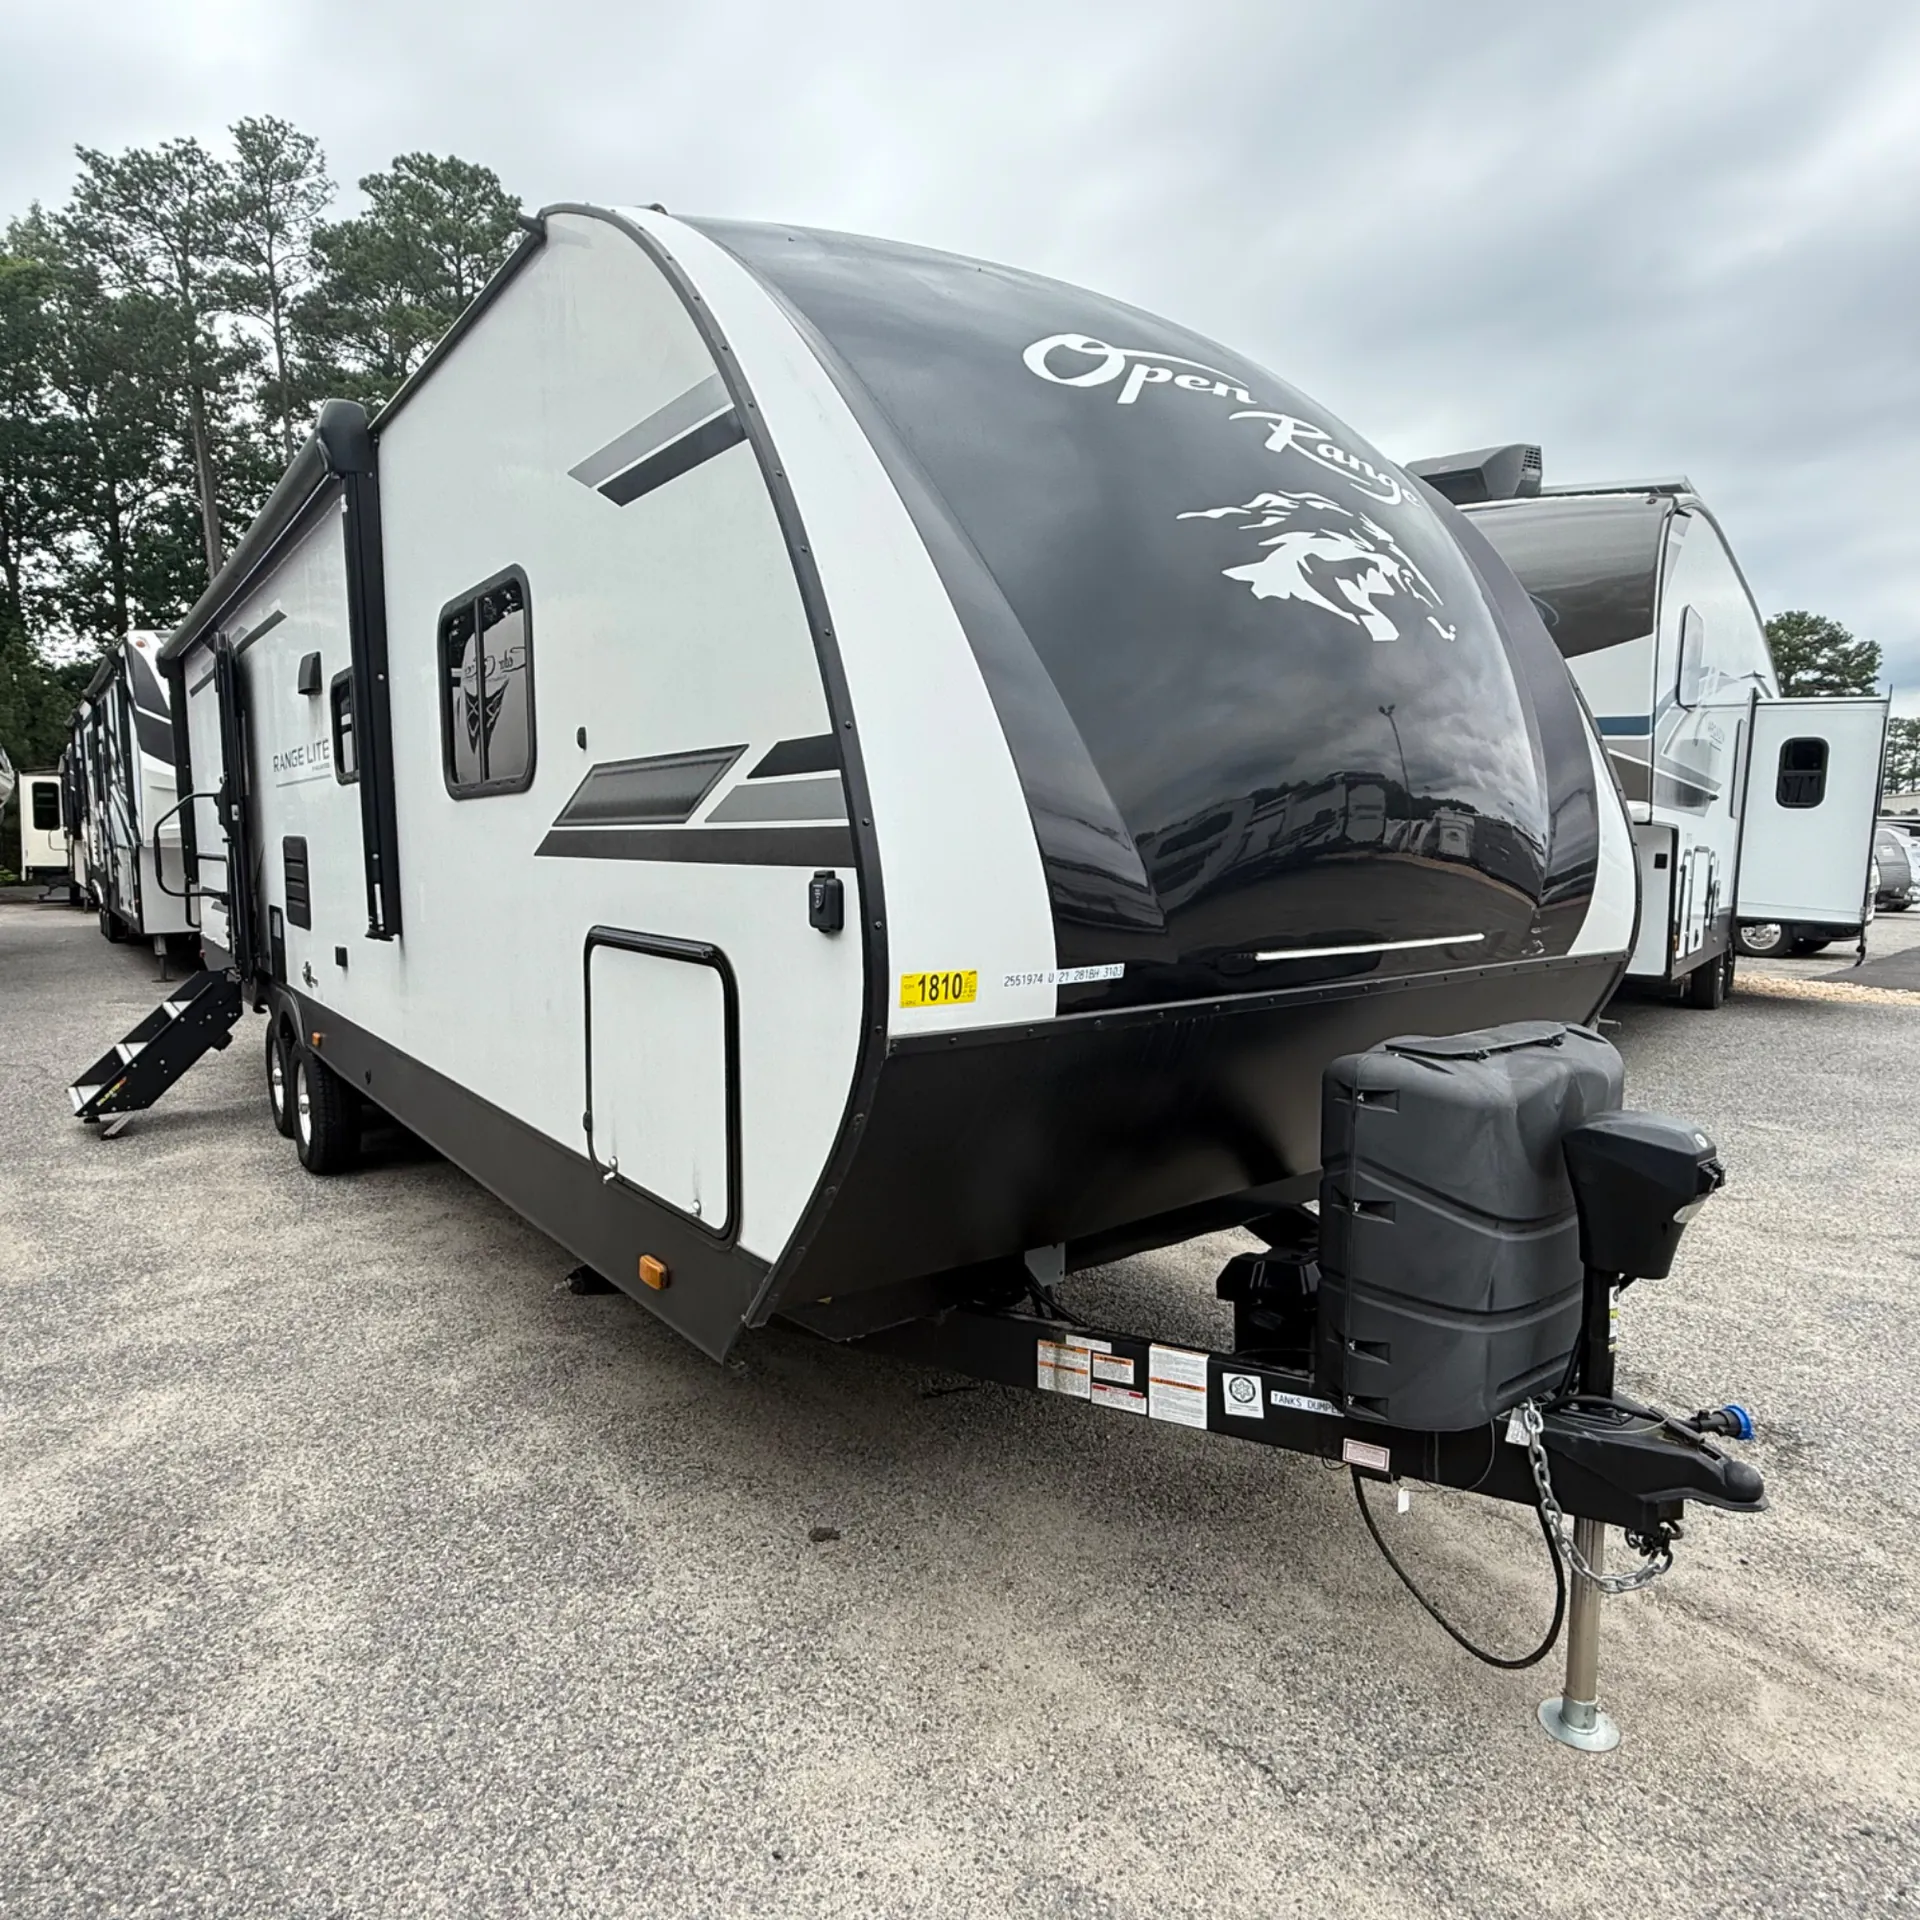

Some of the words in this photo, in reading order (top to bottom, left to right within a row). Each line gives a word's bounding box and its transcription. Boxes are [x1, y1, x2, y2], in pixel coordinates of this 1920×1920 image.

[1023, 333, 1258, 405] Open
[1229, 410, 1422, 507] Range
[273, 746, 305, 772] RANGE
[306, 738, 330, 763] LITE
[917, 973, 963, 1003] 1810
[1003, 973, 1044, 988] 2551974
[1273, 1392, 1303, 1408] TANKS
[1306, 1399, 1342, 1415] DUMPE
